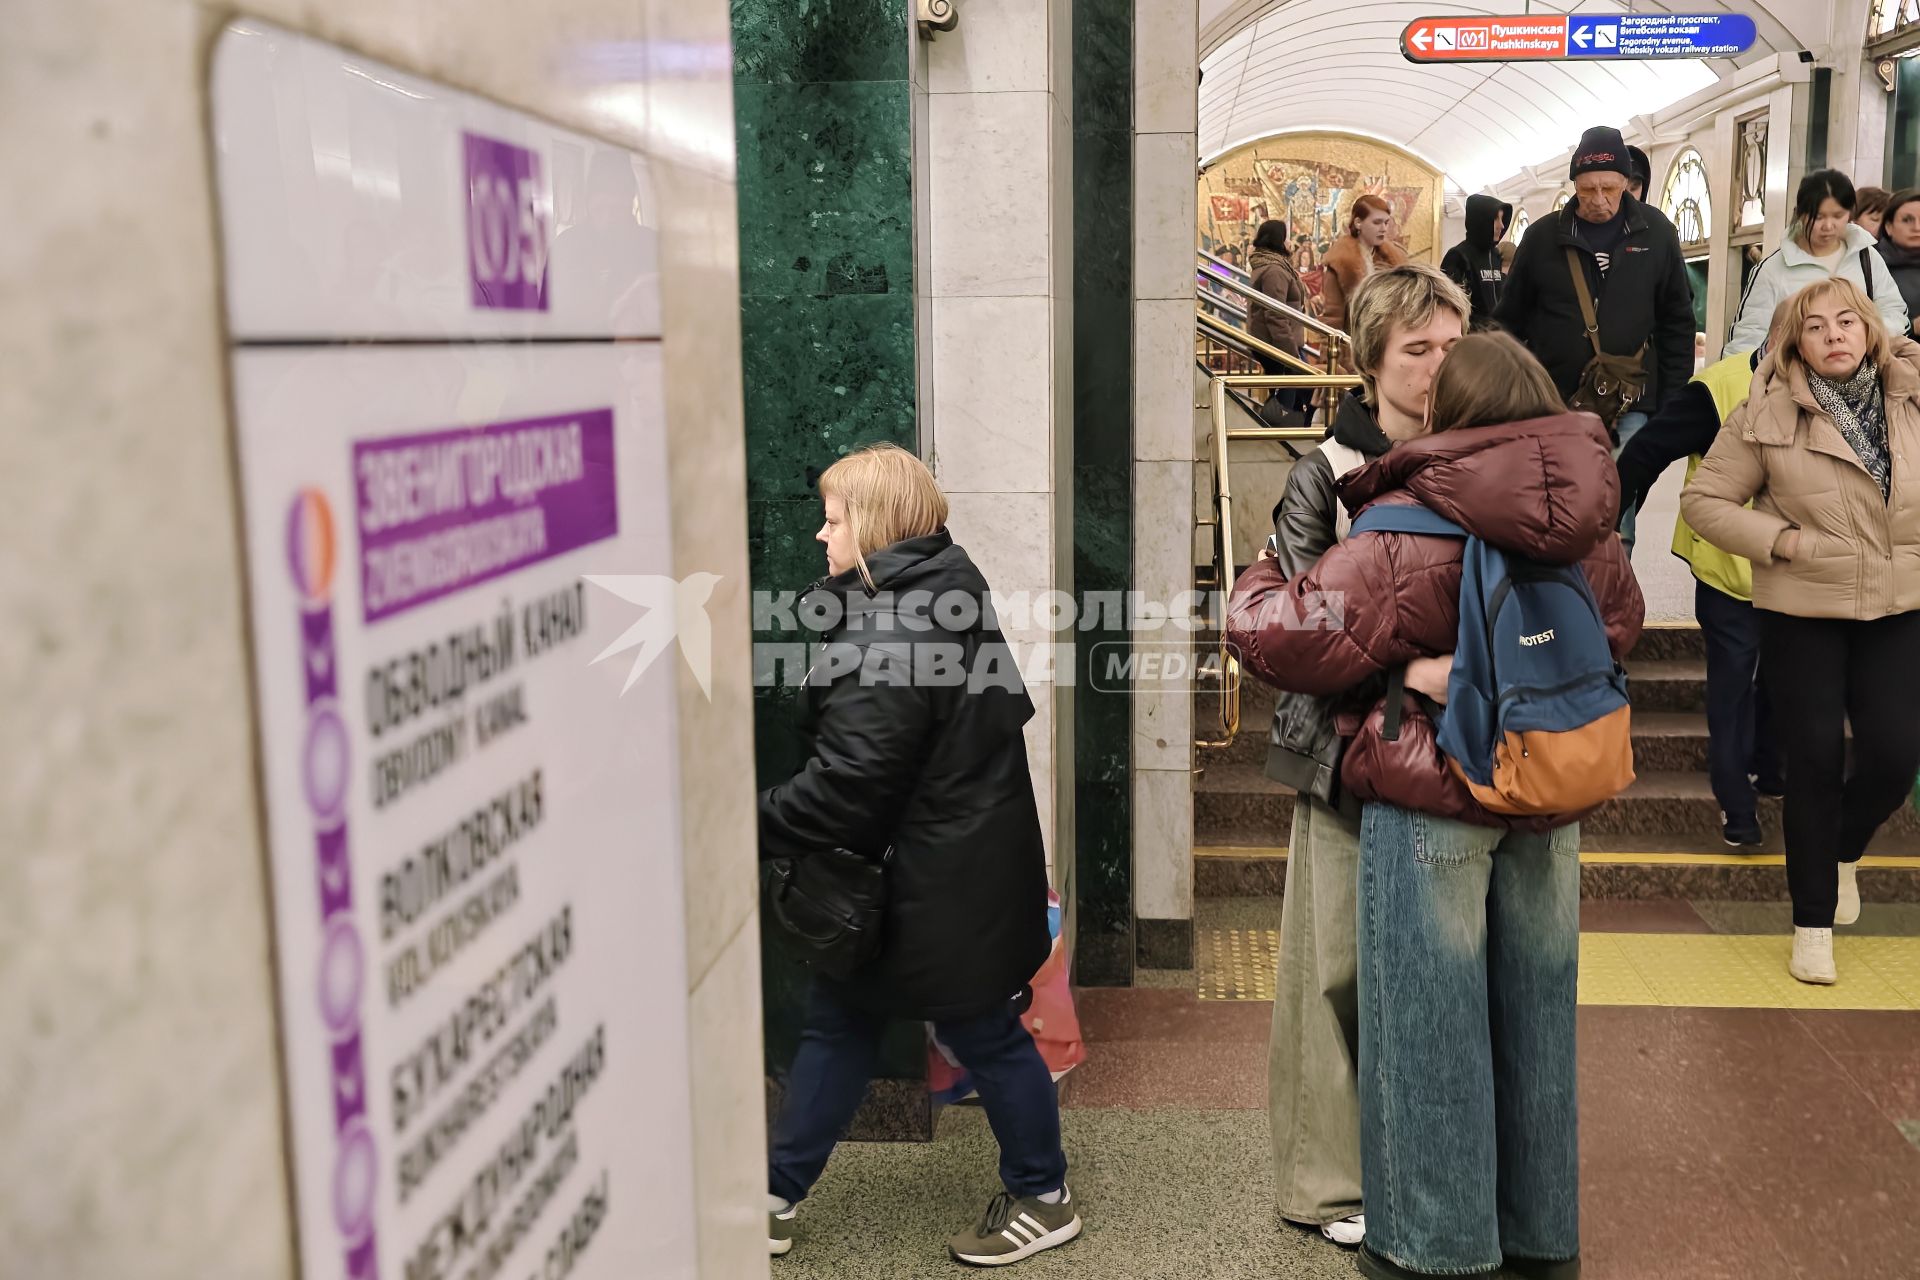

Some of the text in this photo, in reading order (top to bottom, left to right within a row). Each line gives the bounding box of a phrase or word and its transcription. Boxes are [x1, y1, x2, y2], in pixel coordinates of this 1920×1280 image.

[1621, 16, 1721, 25] Загородный проспект,
[1491, 25, 1564, 36] Пушкинская
[1620, 26, 1700, 34] Витебский вокзал
[1491, 39, 1560, 50] Pushkinskaya
[1619, 37, 1692, 46] Zagorodny avenue,
[1619, 46, 1654, 55] Vitebskiy
[1655, 45, 1681, 53] vokzal
[1681, 45, 1710, 54] railway
[365, 580, 586, 736] ОБВОДНЫЙ КАНАЛ
[378, 769, 545, 941] ВОЛКОВСКАЯ
